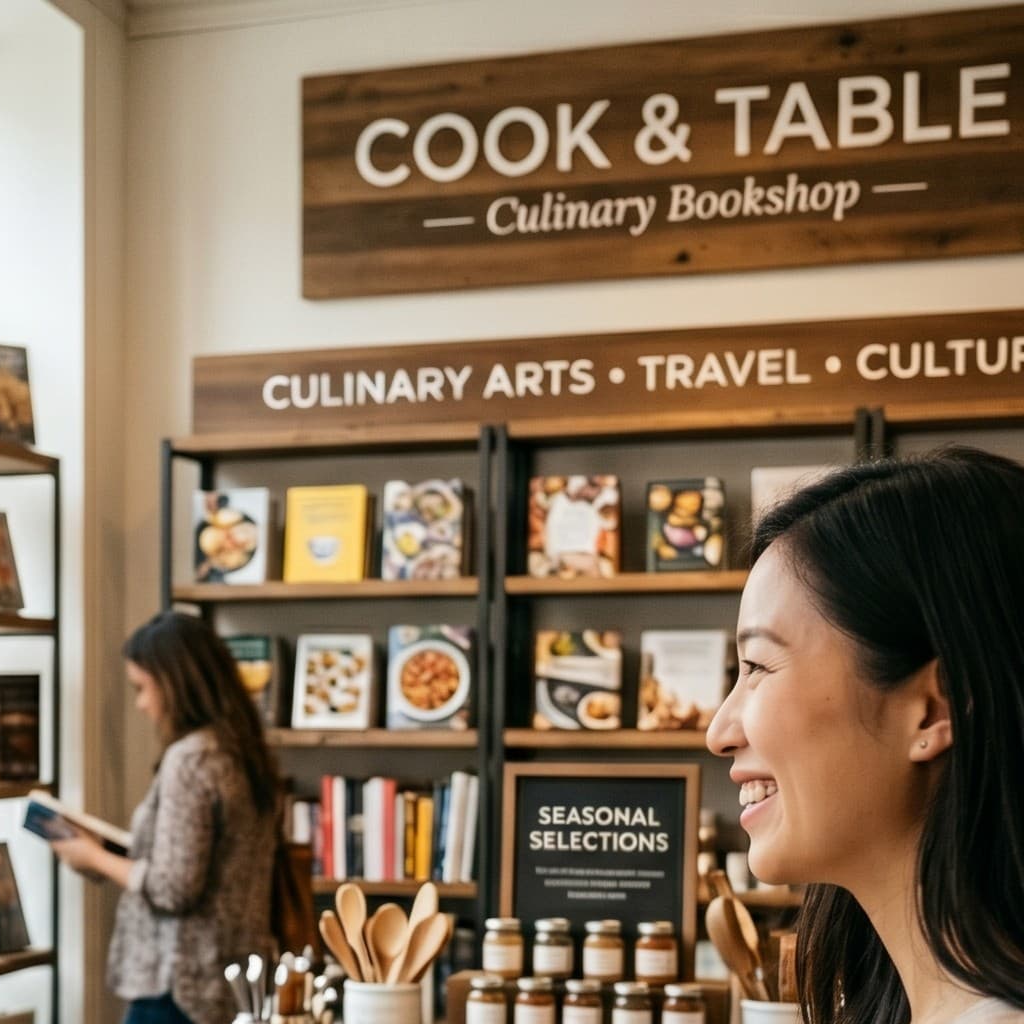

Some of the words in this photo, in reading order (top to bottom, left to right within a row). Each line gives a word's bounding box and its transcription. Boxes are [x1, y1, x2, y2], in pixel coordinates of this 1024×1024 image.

[354, 99, 612, 188] COOK
[633, 93, 693, 166] &
[714, 63, 1011, 158] TABLE
[486, 192, 656, 236] Culinary
[667, 174, 861, 222] Bookshop
[262, 366, 473, 411] CULINARY
[483, 359, 596, 400] ARTS
[638, 349, 811, 392] TRAVEL
[529, 830, 669, 853] SELECTIONS
[538, 806, 661, 827] SEASONAL
